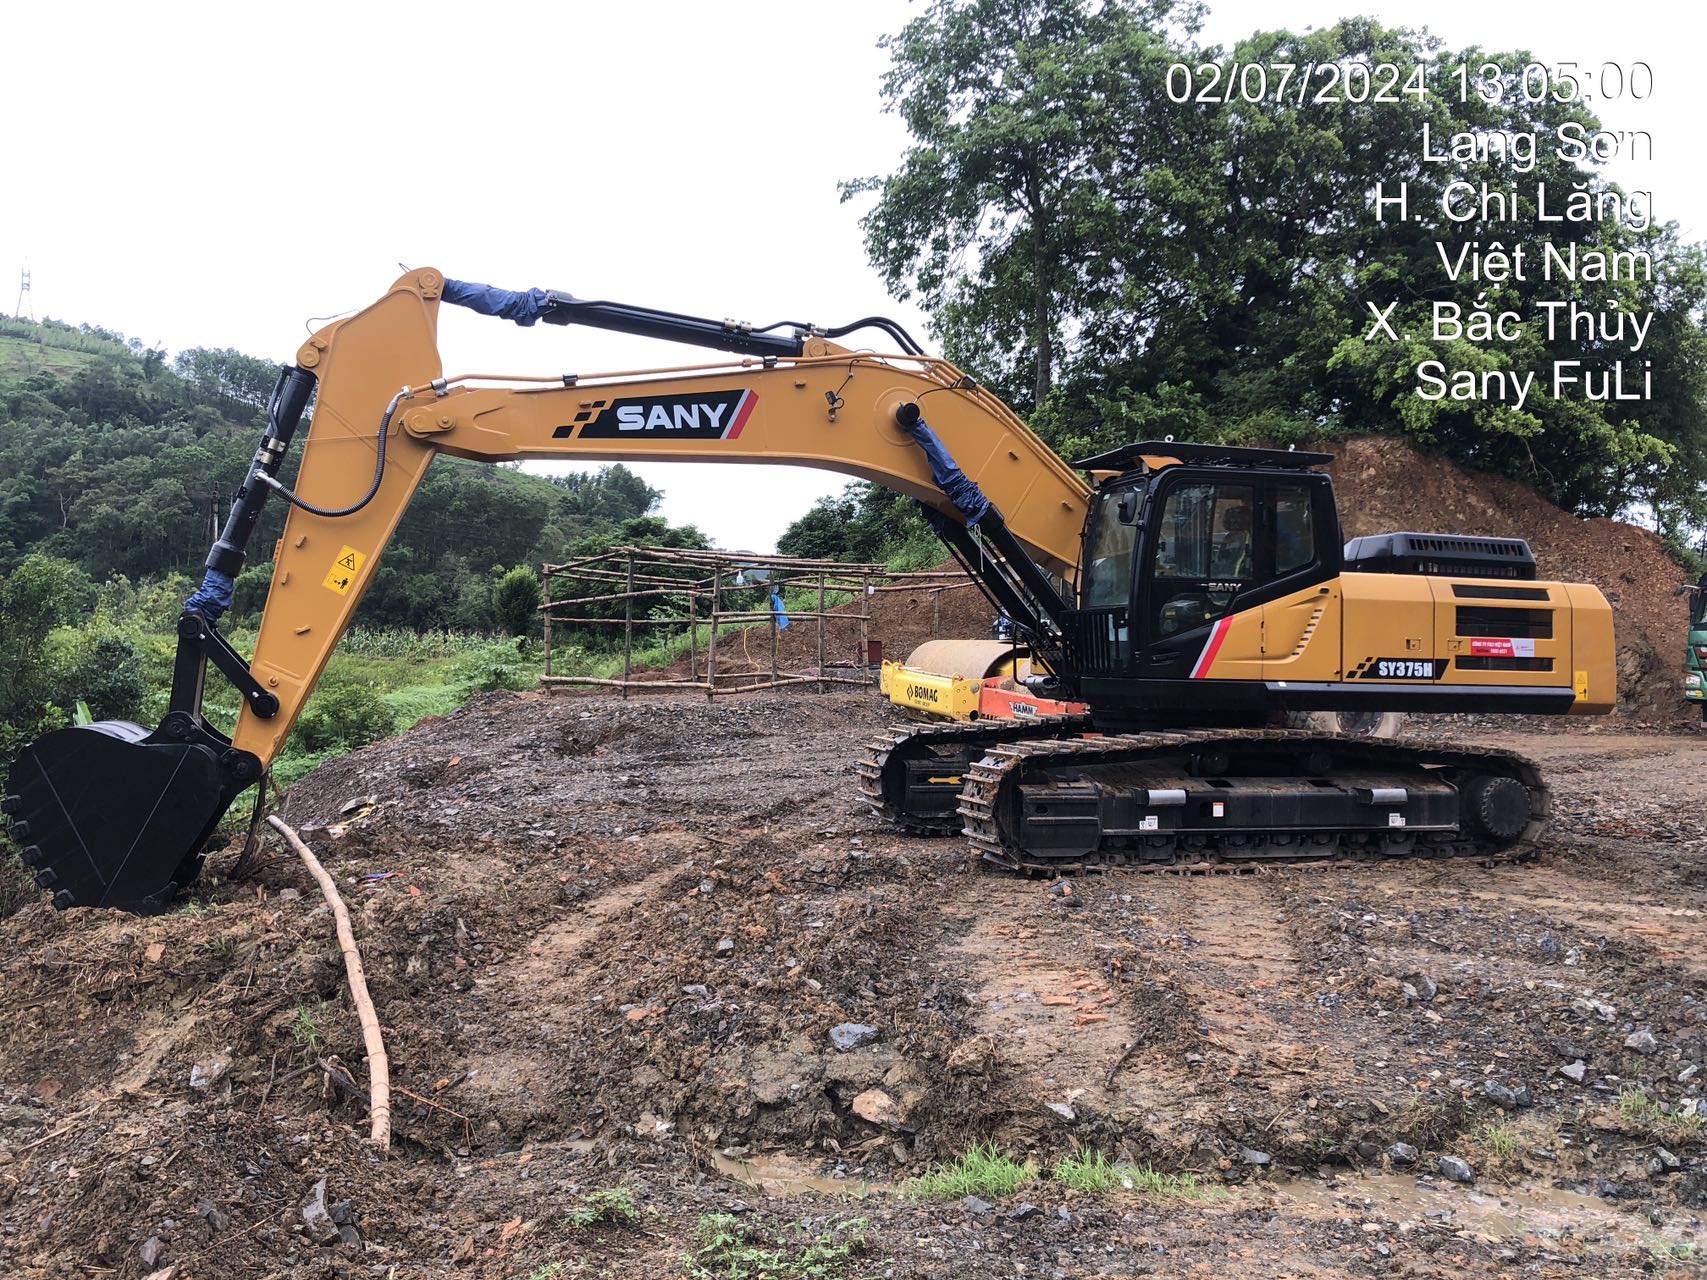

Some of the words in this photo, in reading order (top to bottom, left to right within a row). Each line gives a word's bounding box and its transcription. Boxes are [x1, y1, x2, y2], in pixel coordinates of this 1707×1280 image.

[616, 403, 728, 431] SANY
[1208, 583, 1242, 592] SANY
[1378, 661, 1433, 678] SY375H
[914, 685, 938, 703] BOMAG
[1012, 703, 1034, 715] HAMM
